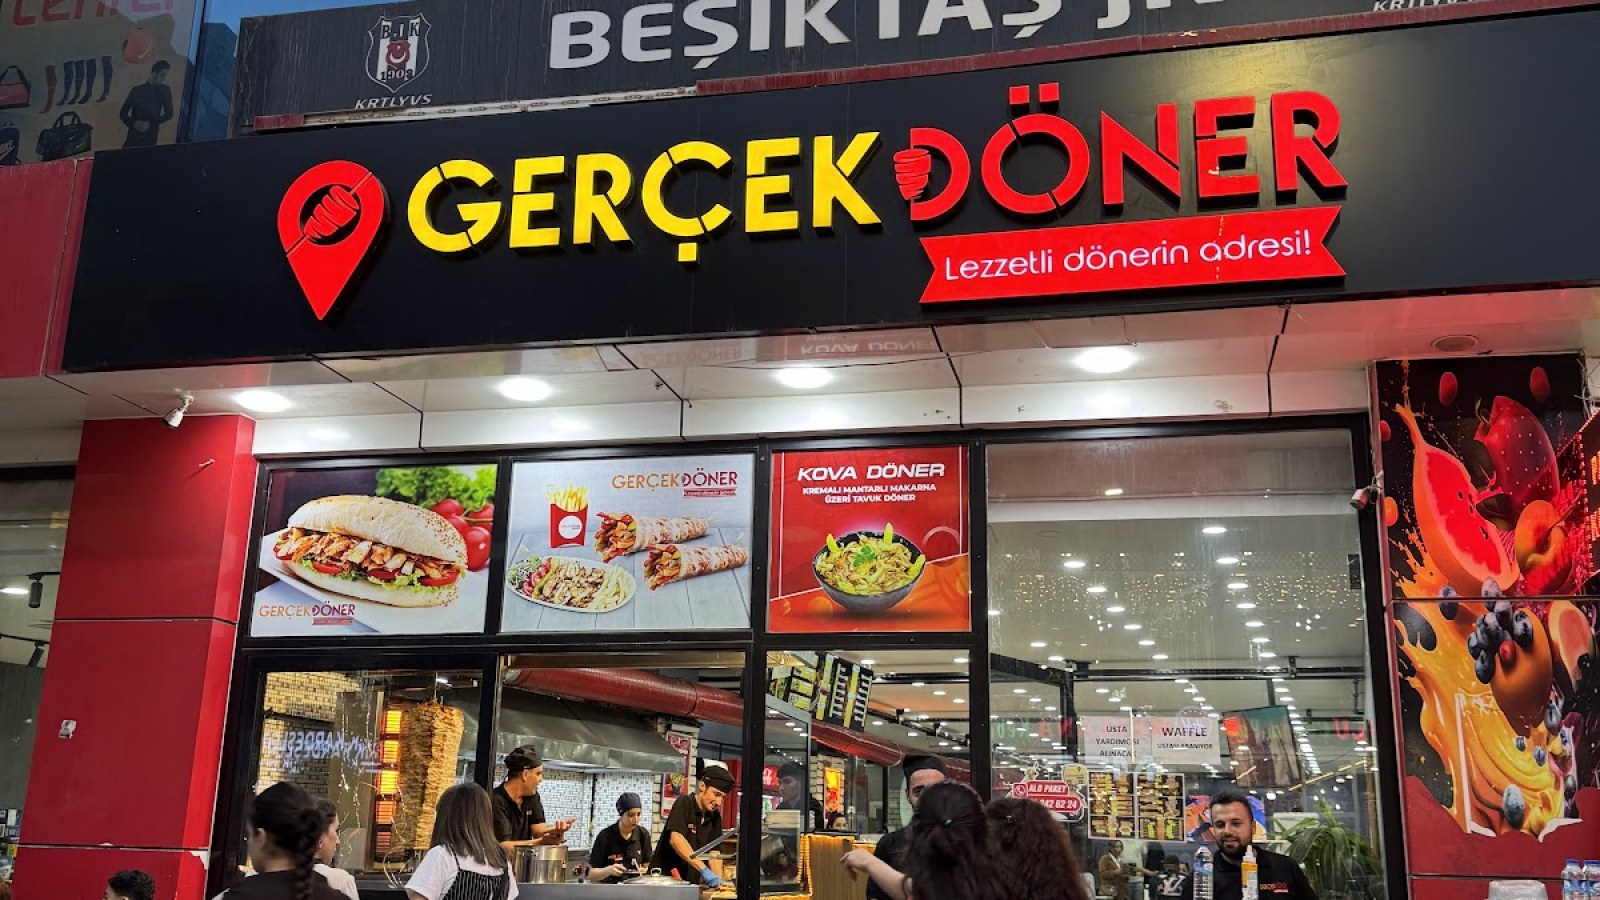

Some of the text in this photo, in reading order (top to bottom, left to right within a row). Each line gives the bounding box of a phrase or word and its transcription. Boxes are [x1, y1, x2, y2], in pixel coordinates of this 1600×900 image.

[946, 230, 1310, 280] Lezzetli dönerin adresi!
[797, 463, 945, 481] KOVA DÖNER
[803, 483, 937, 495] KREMALI MANTARLI MAKARNA
[852, 494, 882, 503] TAVUK
[883, 493, 916, 502] DÖNER
[1106, 725, 1128, 733] USTA
[1161, 727, 1208, 737] WAFFLE
[1043, 783, 1067, 793] PAKET
[1055, 800, 1065, 809] 62
[1067, 800, 1078, 809] 24
